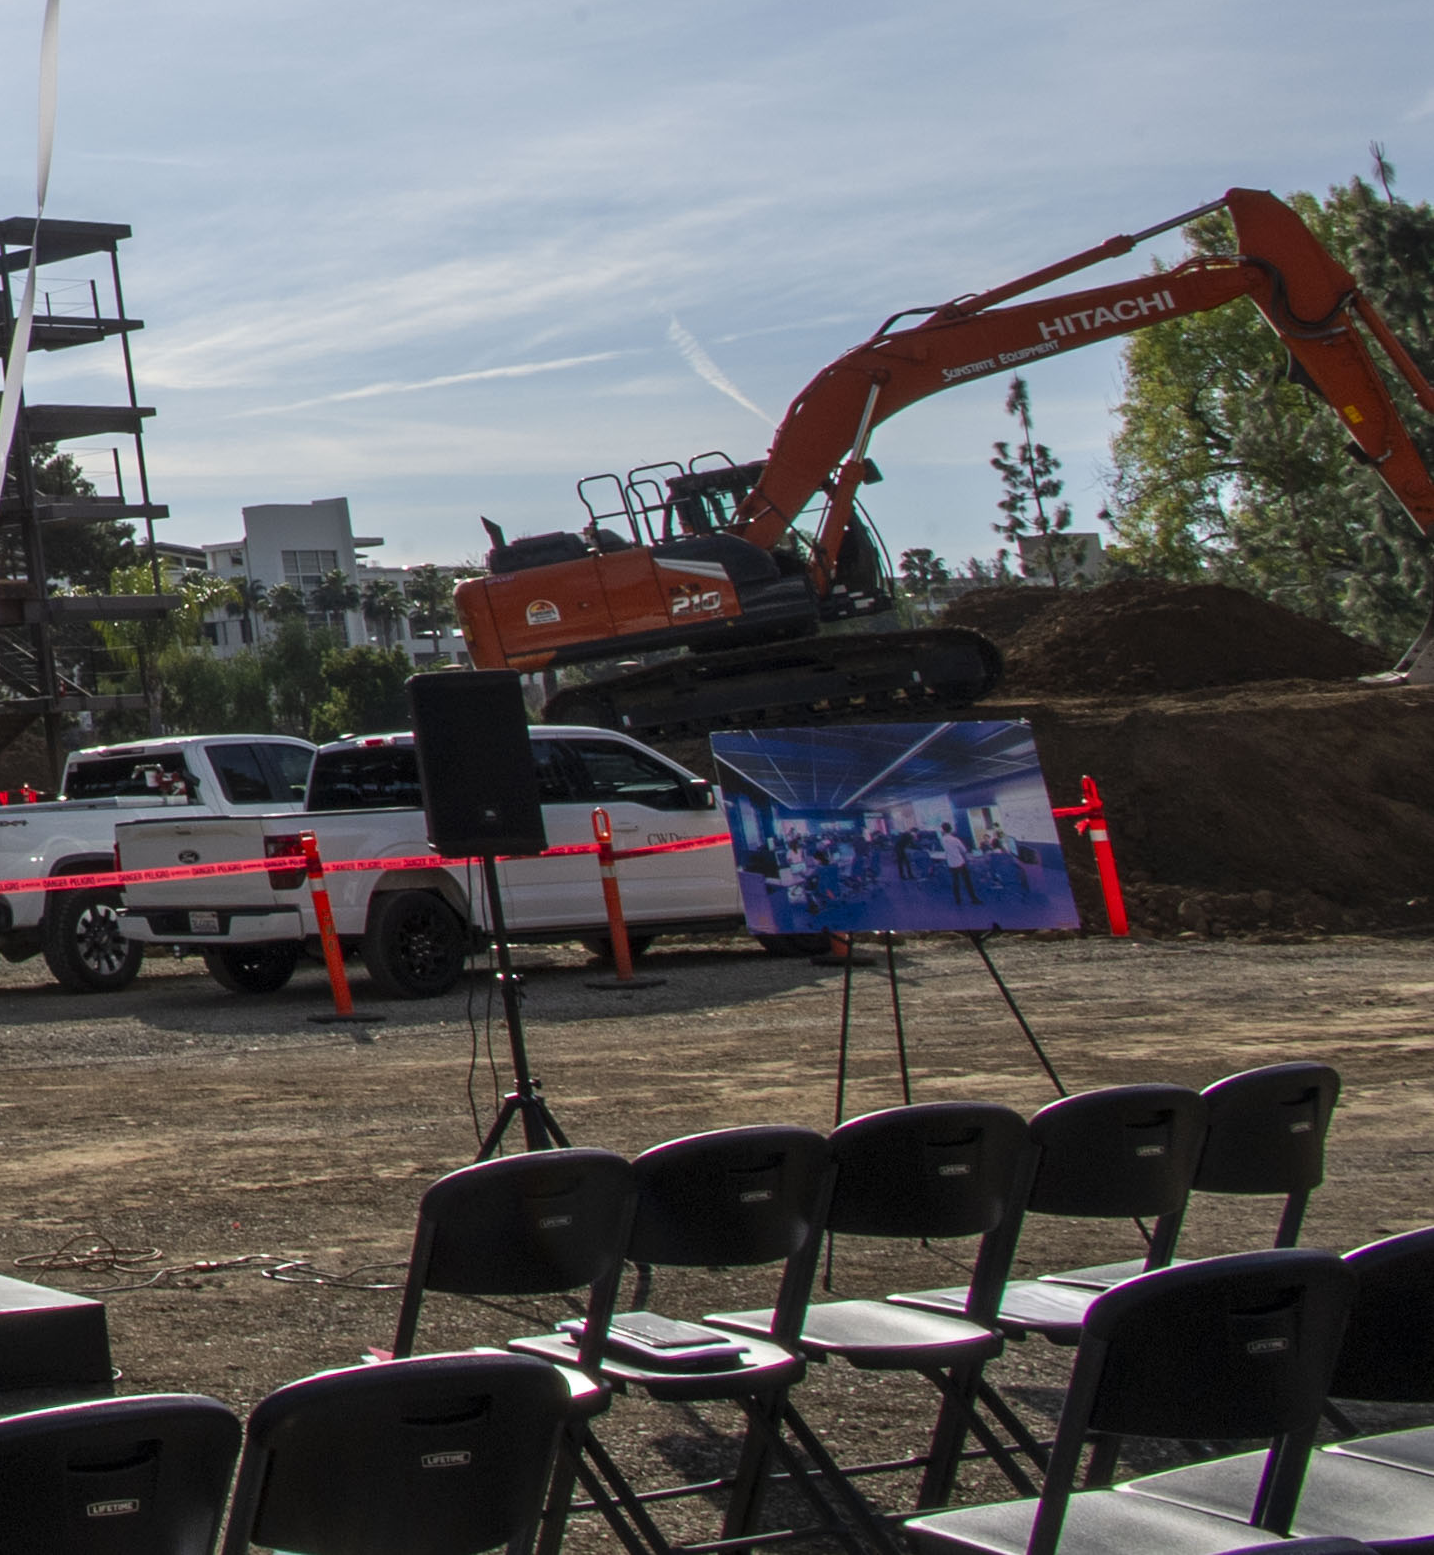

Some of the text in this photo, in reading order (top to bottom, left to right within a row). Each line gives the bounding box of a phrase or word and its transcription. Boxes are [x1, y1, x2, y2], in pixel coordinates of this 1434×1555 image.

[1038, 290, 1176, 340] HITACHI
[42, 879, 68, 889] DANGER
[70, 876, 96, 886] PELIGRO
[118, 872, 143, 882] DANGER
[145, 870, 170, 879] PELIGRO
[192, 866, 216, 876] DANGER
[218, 863, 243, 874] PELIGRO
[425, 1453, 466, 1466] LIFETIME
[90, 1501, 135, 1515] LIFETIME
